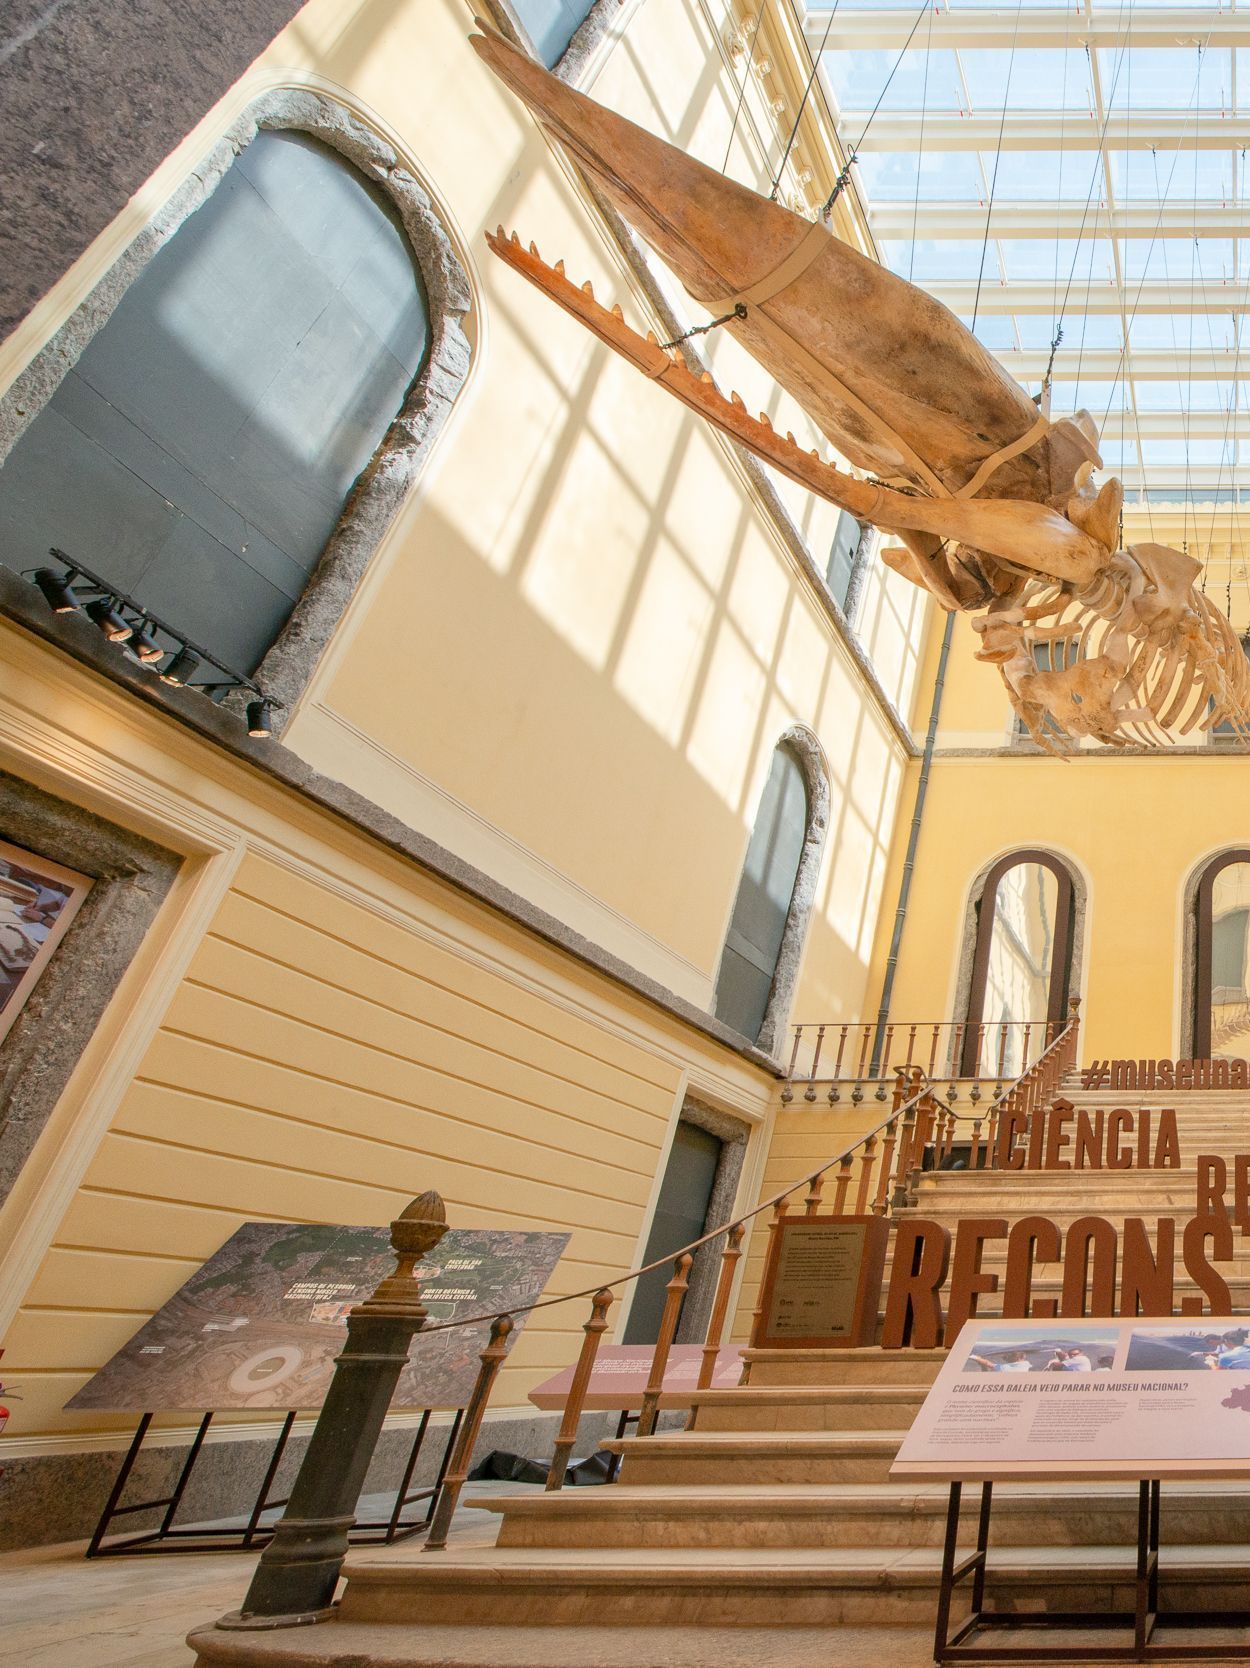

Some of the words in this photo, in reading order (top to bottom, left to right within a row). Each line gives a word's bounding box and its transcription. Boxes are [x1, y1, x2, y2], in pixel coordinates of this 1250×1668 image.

[999, 1097, 1182, 1170] CIÊNCIA
[952, 1384, 981, 1393] COMO
[979, 1384, 1005, 1393] ESSA
[1005, 1383, 1038, 1393] BALEIA
[1039, 1383, 1060, 1393] VEIO
[1060, 1383, 1091, 1392] PARAR
[1092, 1383, 1106, 1392] NO
[1106, 1383, 1139, 1392] MUSEU
[1140, 1382, 1189, 1392] NACIONAL?
